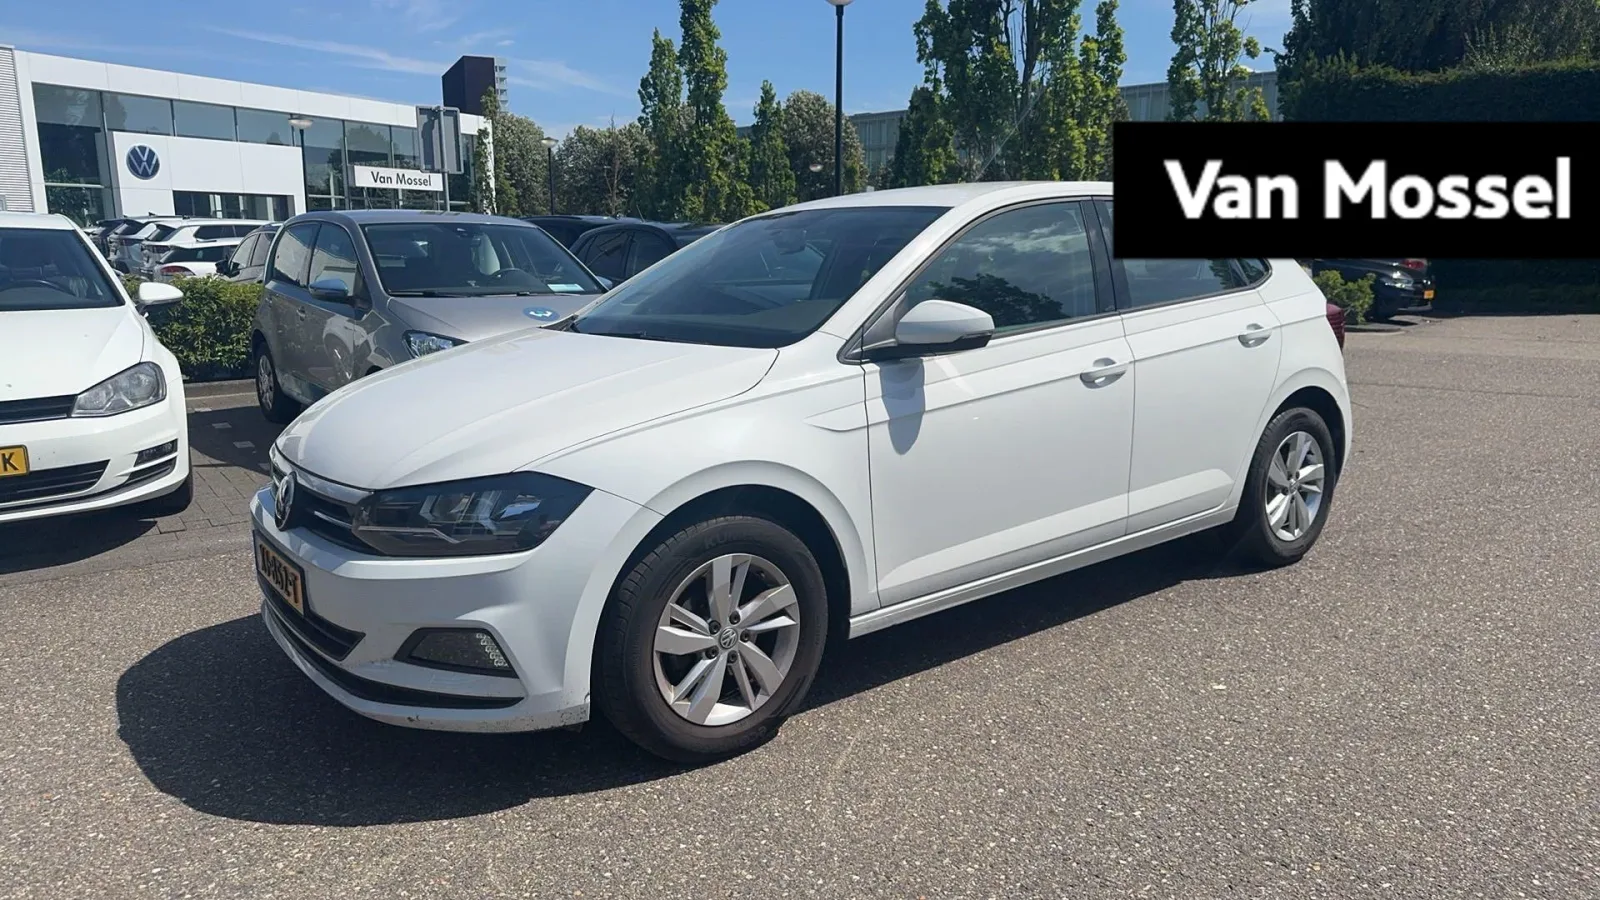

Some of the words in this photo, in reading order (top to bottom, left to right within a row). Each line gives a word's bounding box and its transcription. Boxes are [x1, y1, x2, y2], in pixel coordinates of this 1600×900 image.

[370, 171, 393, 184] Van
[395, 172, 432, 186] Mossel
[1, 452, 19, 472] K
